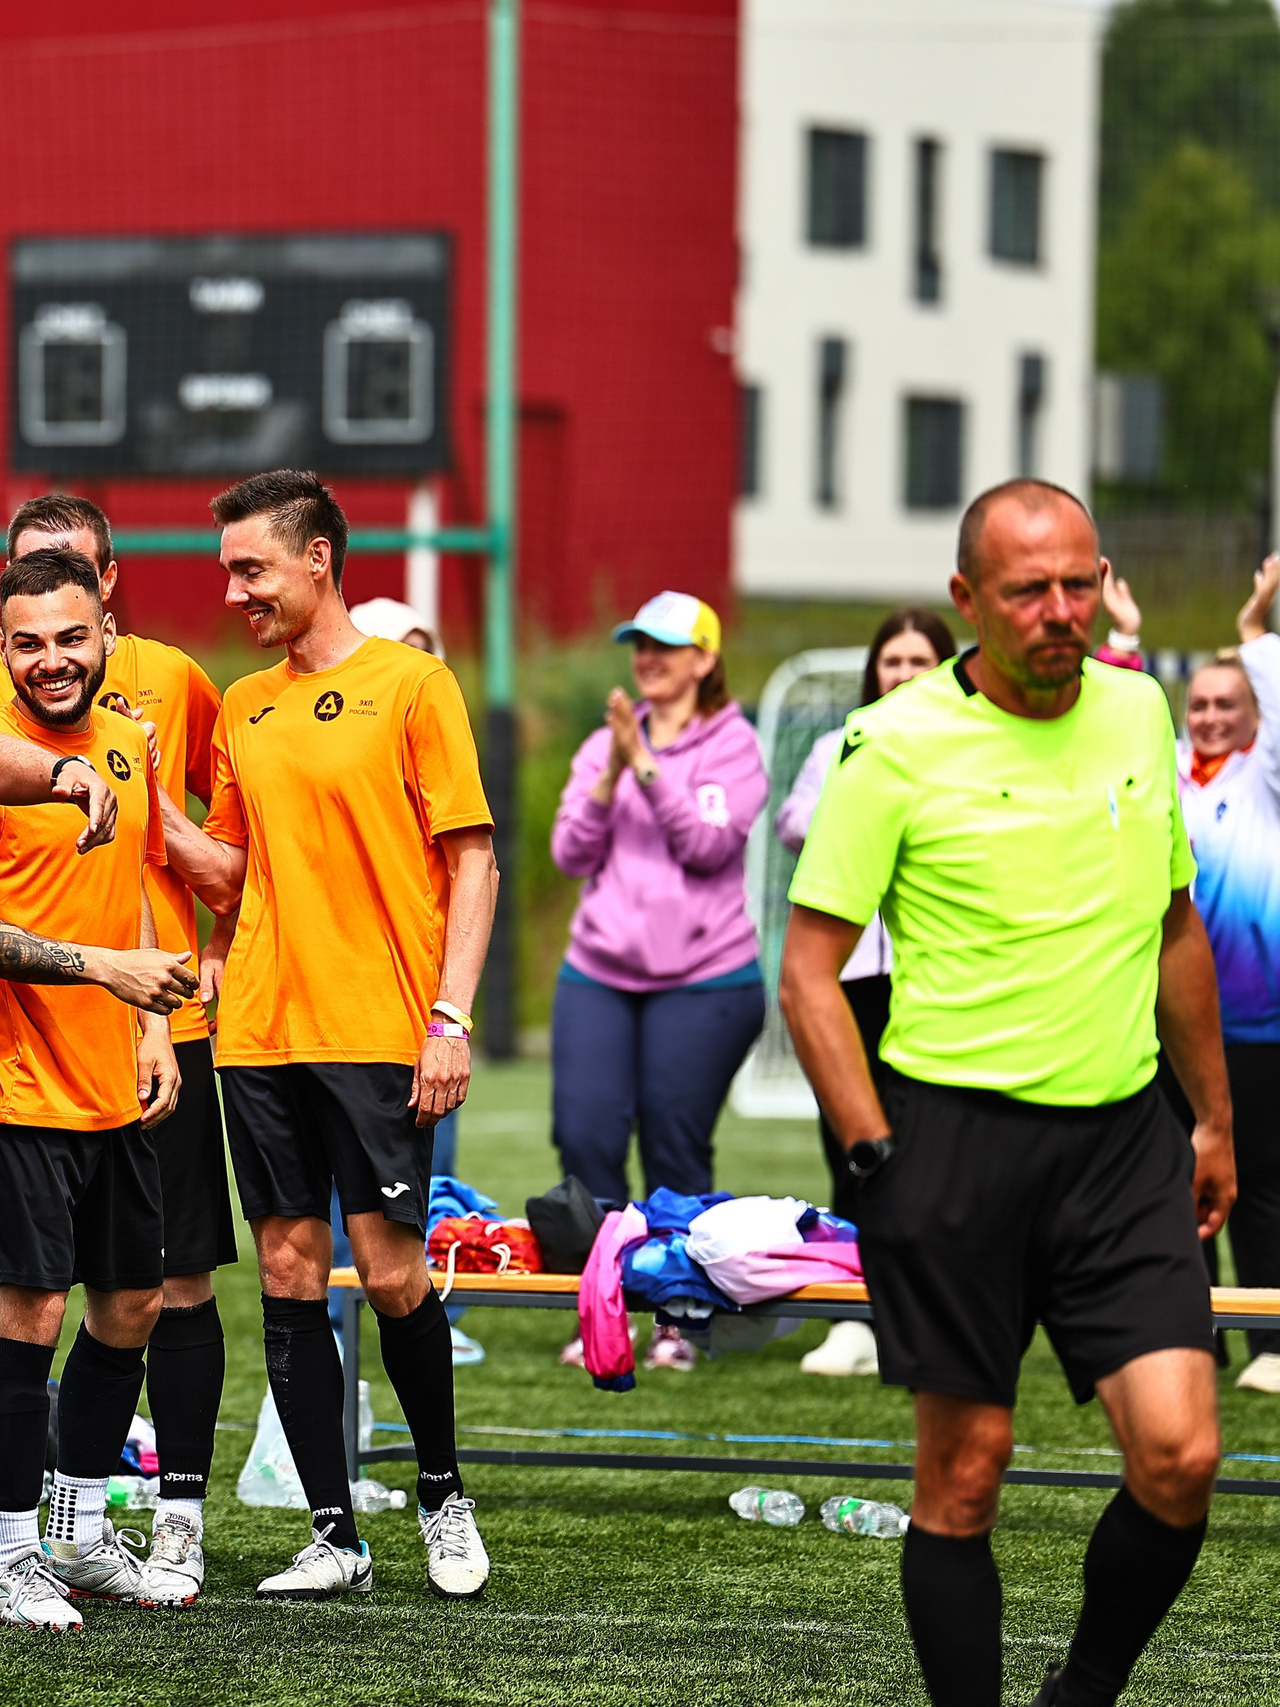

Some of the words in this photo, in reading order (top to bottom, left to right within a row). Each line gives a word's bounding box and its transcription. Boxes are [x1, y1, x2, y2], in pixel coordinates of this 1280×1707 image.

[137, 689, 153, 698] ЭХП
[358, 699, 374, 707] ЭХП
[349, 708, 378, 716] РОСАТОМ
[164, 1472, 204, 1482] Joma
[312, 1506, 344, 1518] oma
[12, 1556, 37, 1573] oma
